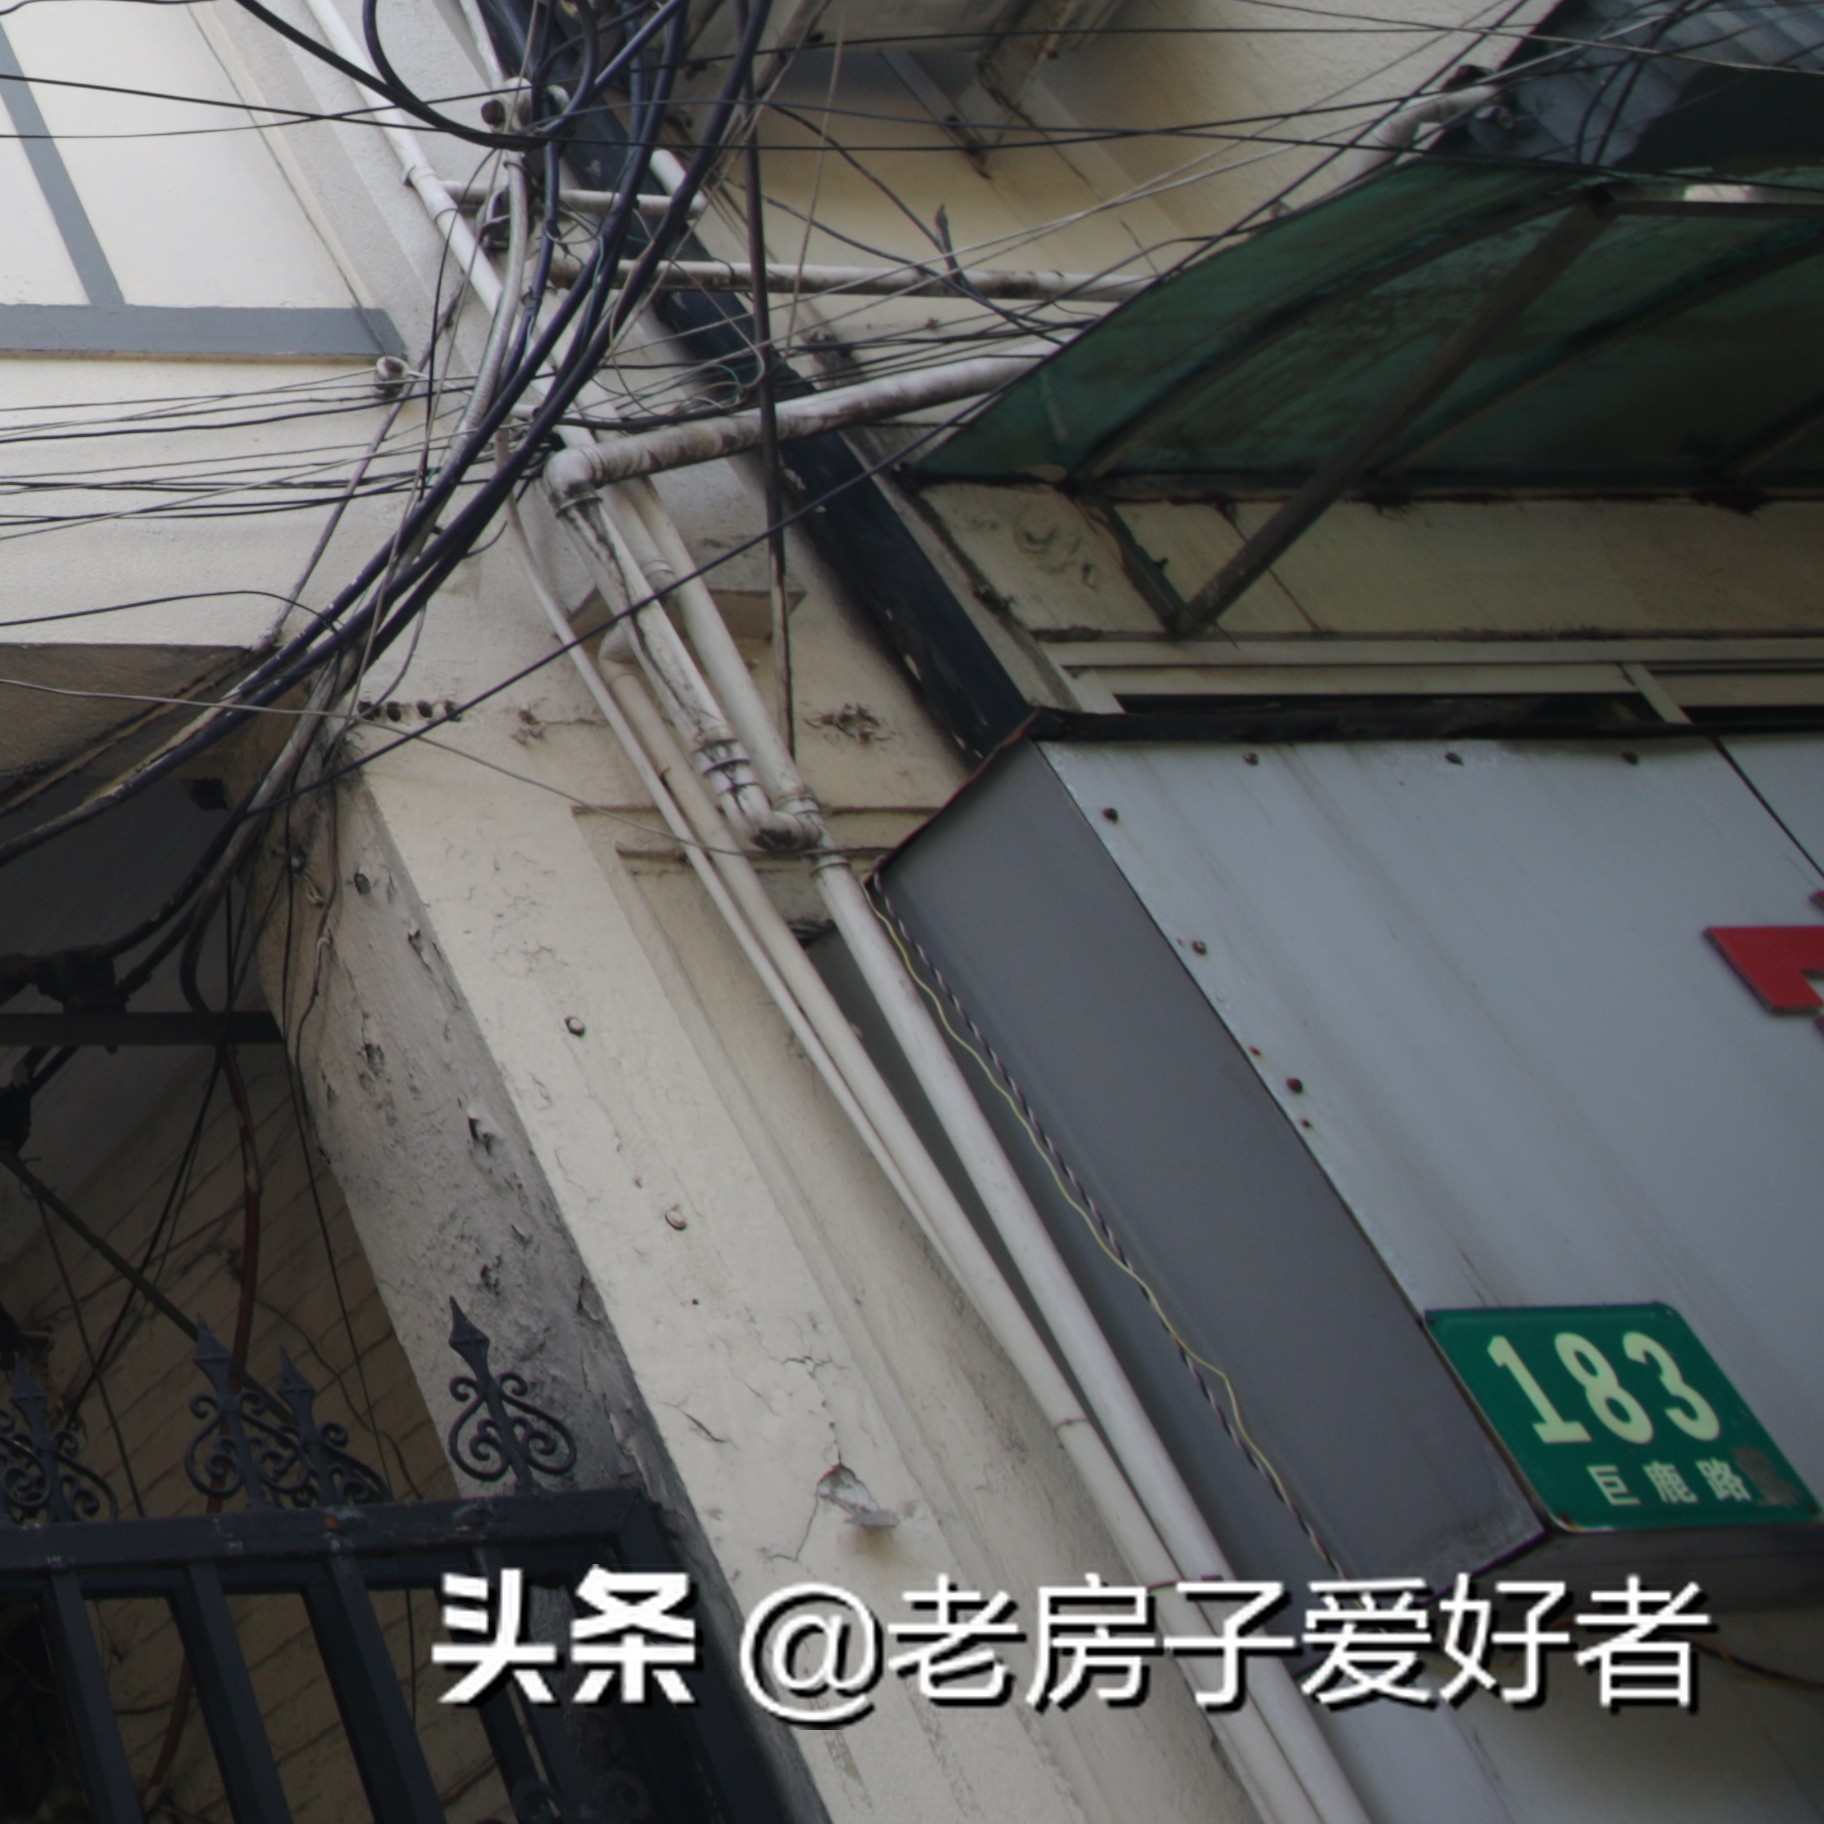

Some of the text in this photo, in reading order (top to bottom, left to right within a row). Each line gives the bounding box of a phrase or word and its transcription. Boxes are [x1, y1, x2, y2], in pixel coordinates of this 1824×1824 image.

[1487, 1330, 1721, 1445] 183
[1587, 1457, 1752, 1506] 巨鹿路
